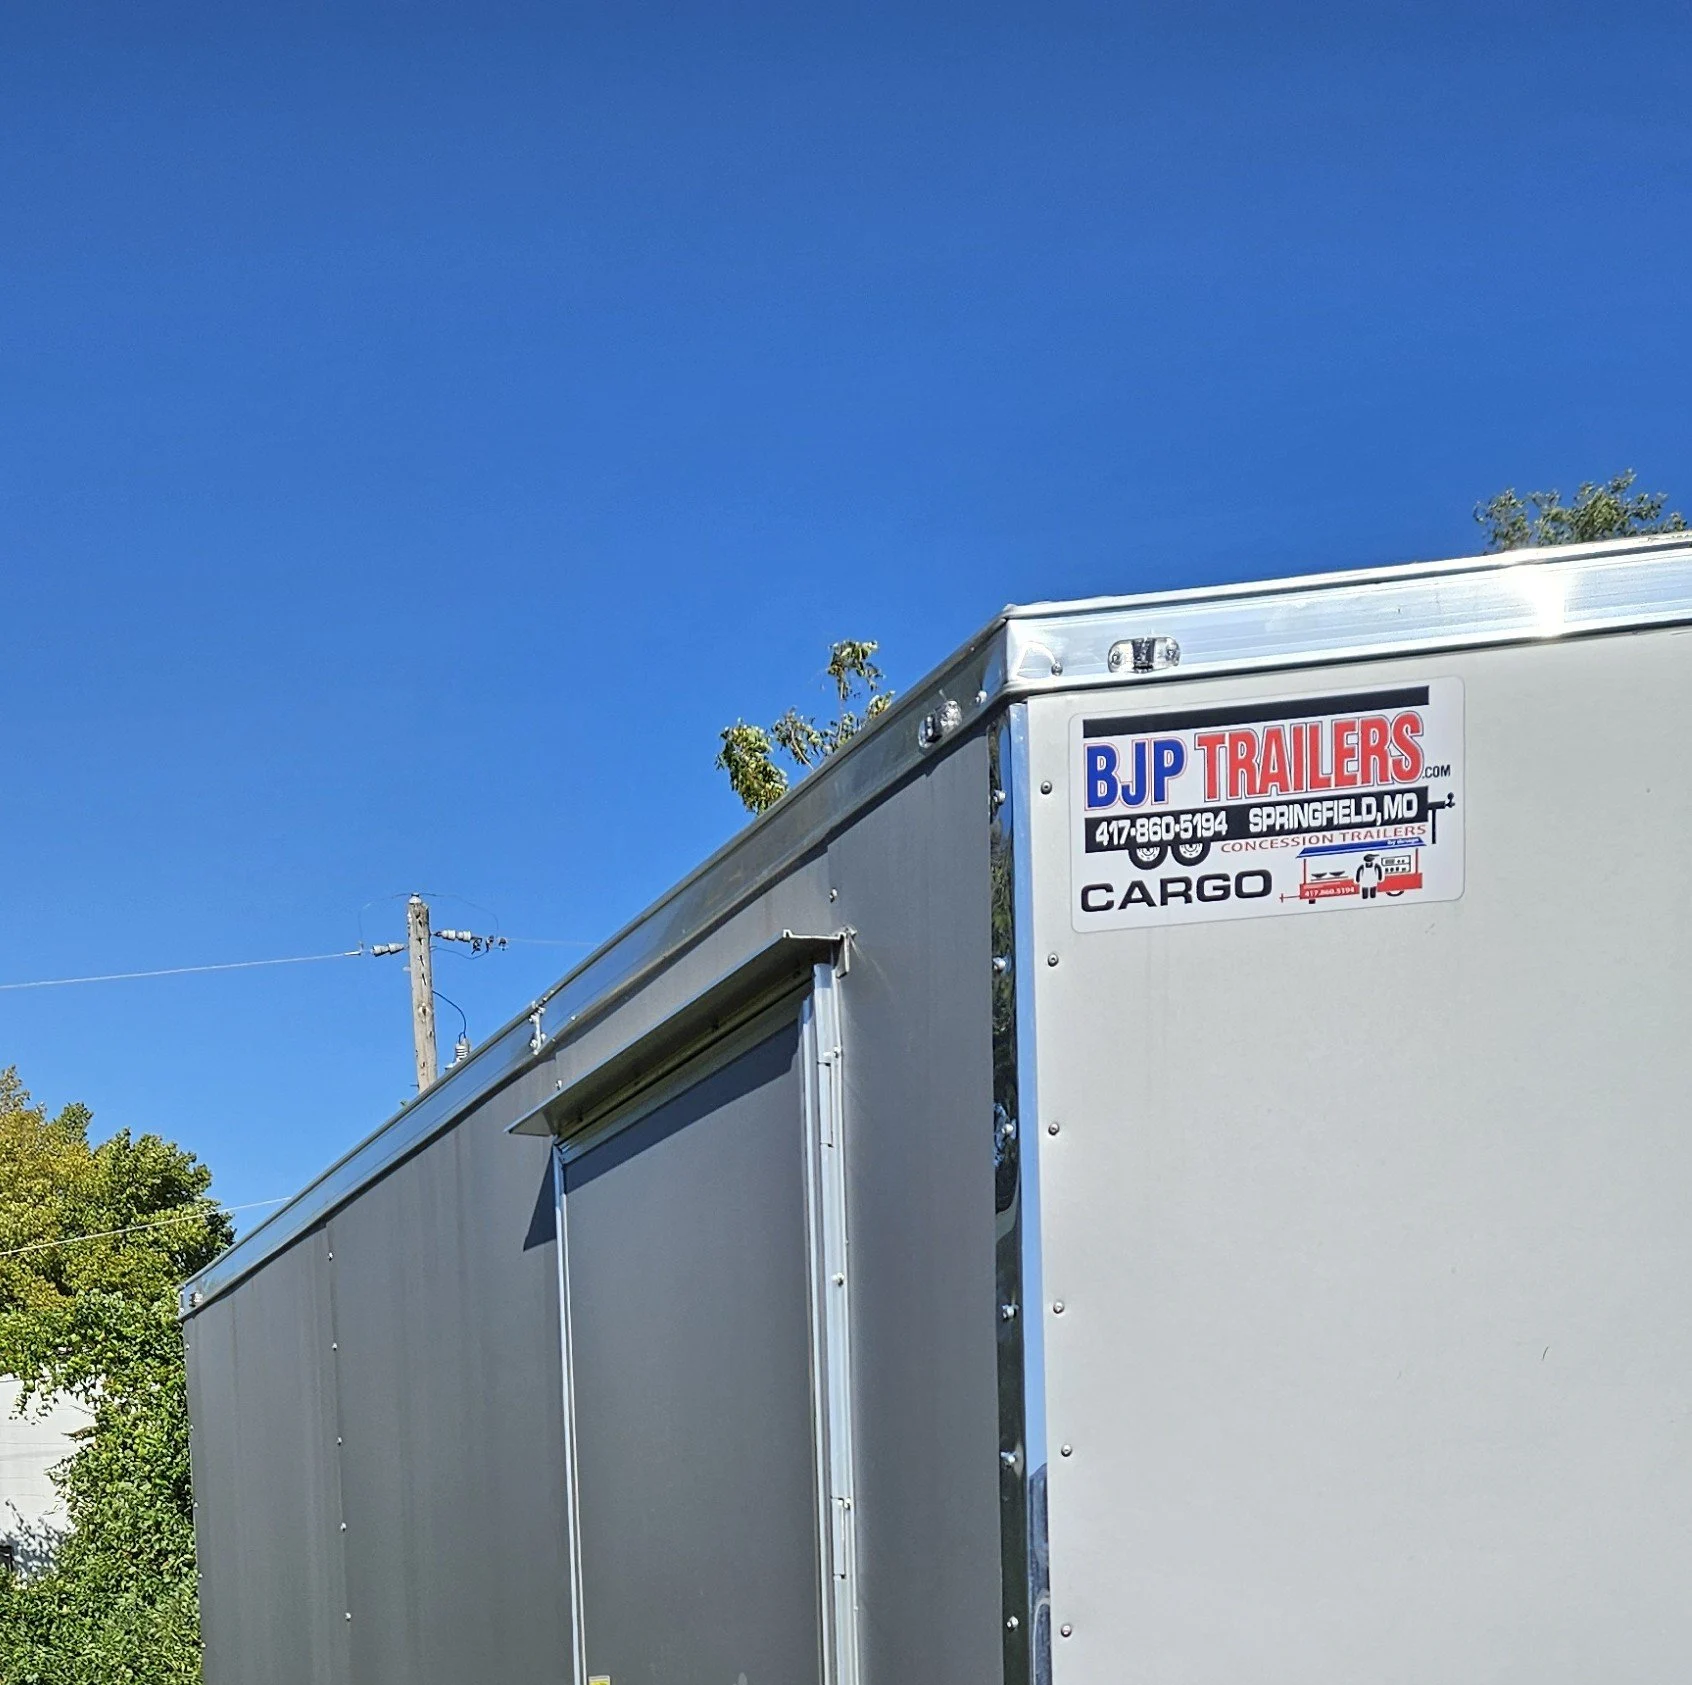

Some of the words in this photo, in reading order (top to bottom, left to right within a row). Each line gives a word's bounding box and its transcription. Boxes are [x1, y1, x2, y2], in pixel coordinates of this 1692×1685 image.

[1084, 737, 1187, 811] BJP
[1194, 711, 1424, 802] TRAILERS
[1422, 764, 1451, 779] .COM
[1221, 835, 1338, 852] CONCESSION
[1341, 825, 1427, 843] TRAILERS
[1081, 869, 1272, 912] CARGO
